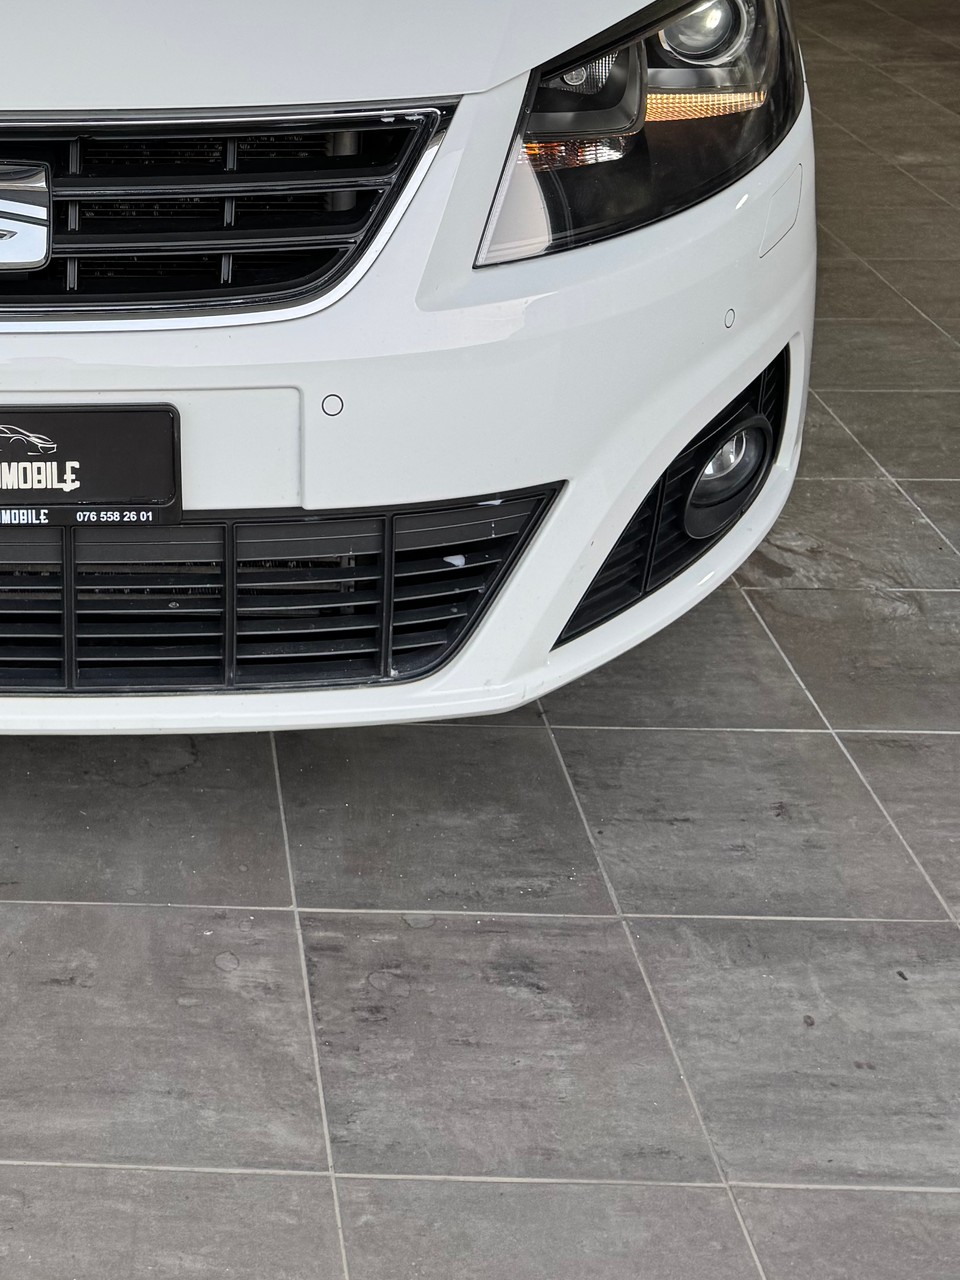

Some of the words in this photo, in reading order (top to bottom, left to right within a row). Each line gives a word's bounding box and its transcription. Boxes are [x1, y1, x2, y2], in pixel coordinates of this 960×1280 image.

[76, 511, 98, 522] 076
[100, 511, 121, 522] 558
[122, 511, 138, 522] 26
[139, 511, 153, 522] 01
